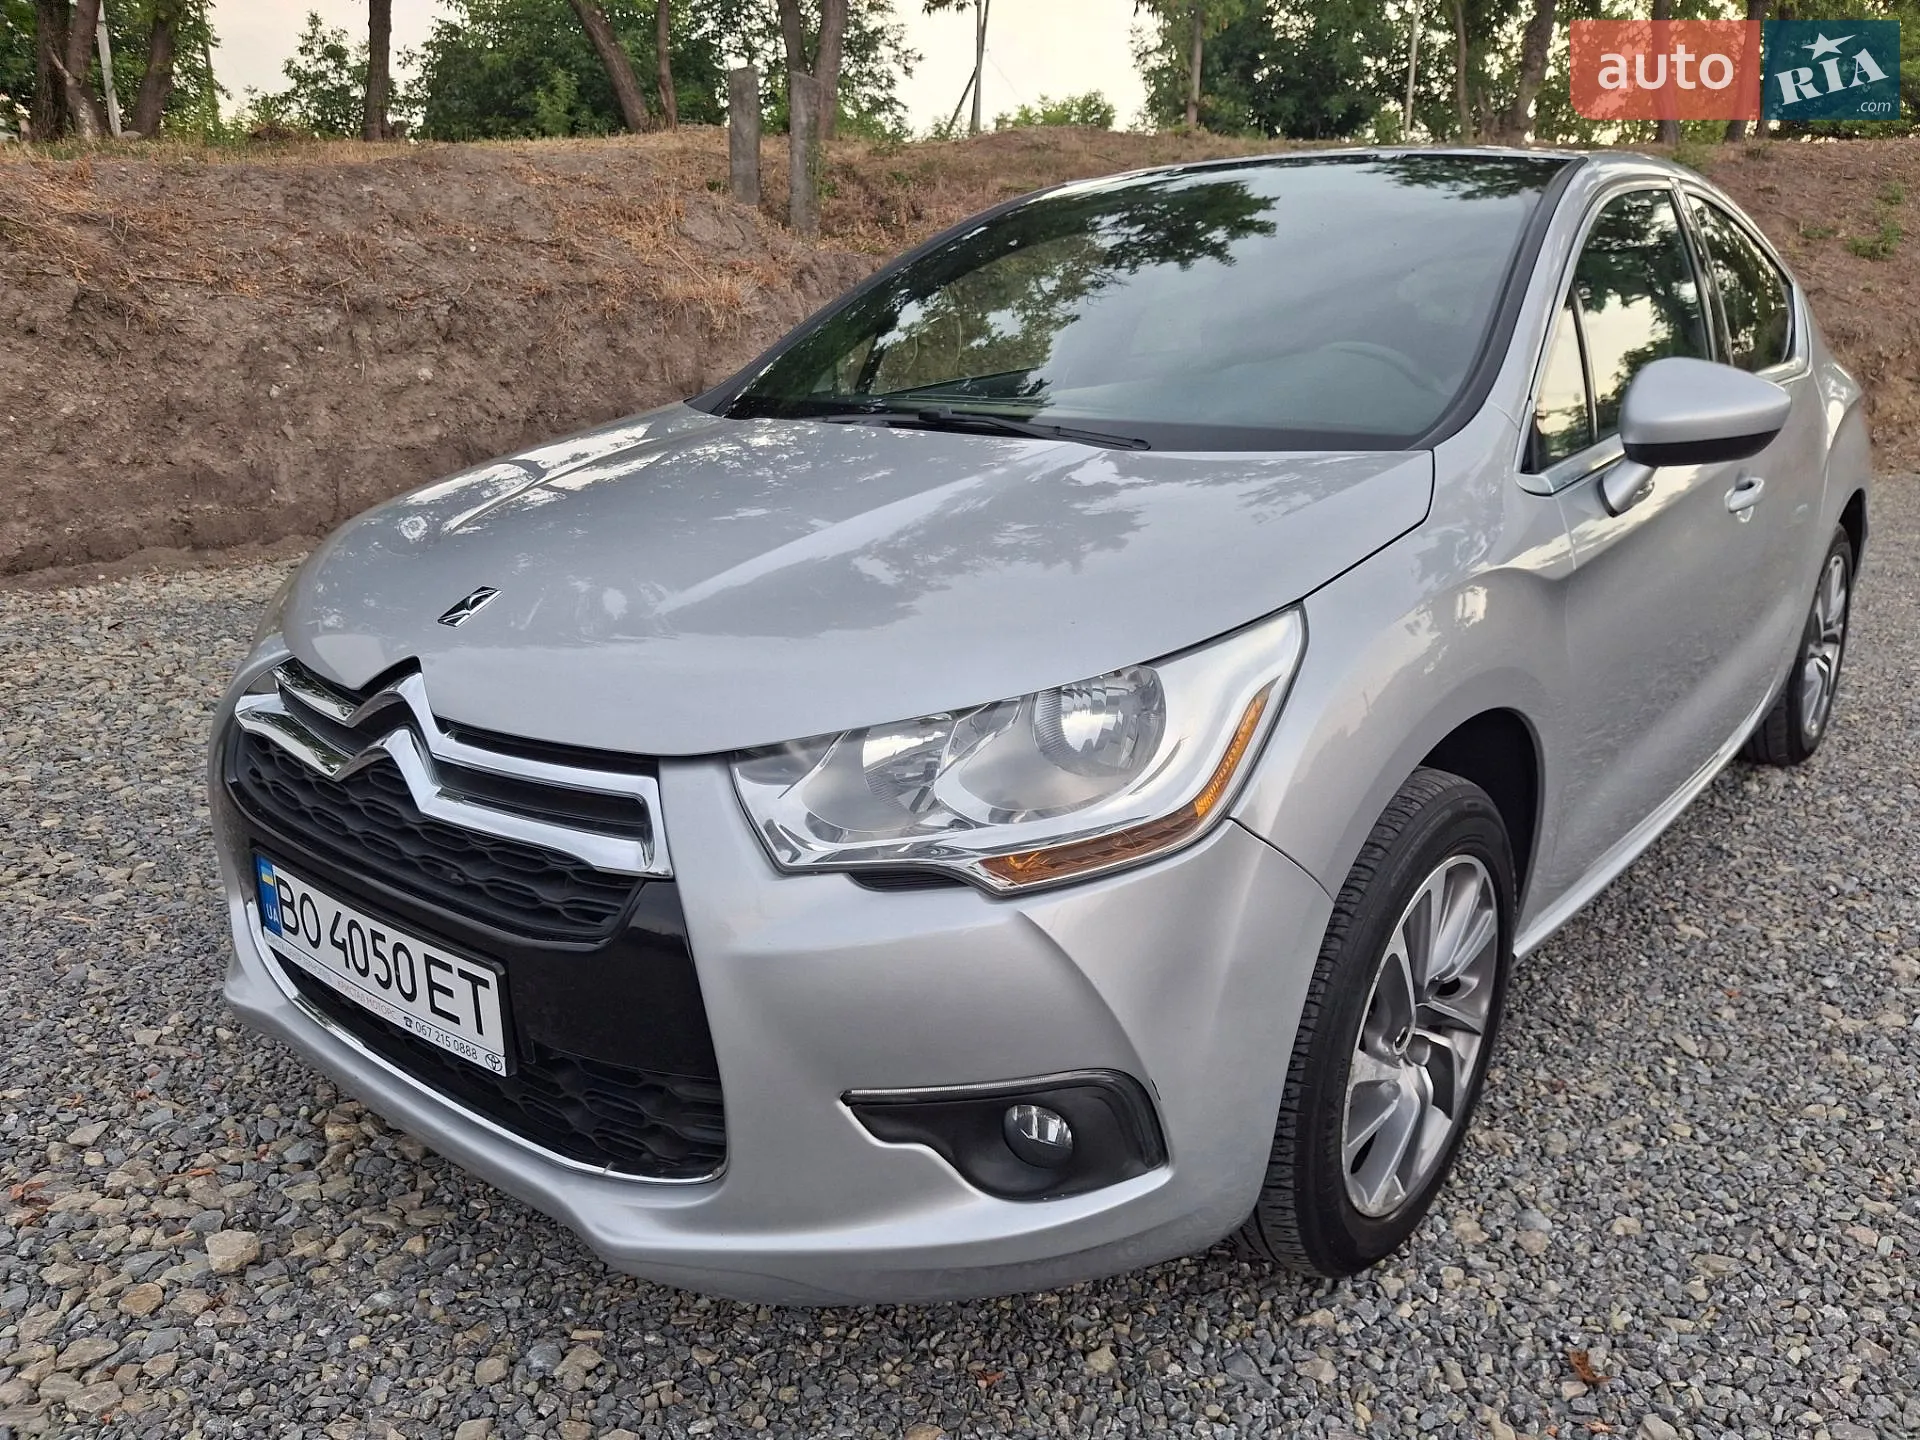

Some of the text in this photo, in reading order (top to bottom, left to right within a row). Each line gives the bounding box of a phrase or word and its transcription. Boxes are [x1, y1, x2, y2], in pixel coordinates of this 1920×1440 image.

[265, 903, 280, 924] UA
[276, 875, 321, 949] BO
[330, 911, 418, 1002] 4050
[424, 953, 490, 1035] ET
[415, 1021, 432, 1038] 067
[435, 1031, 451, 1048] 215
[453, 1039, 478, 1060] 0888
